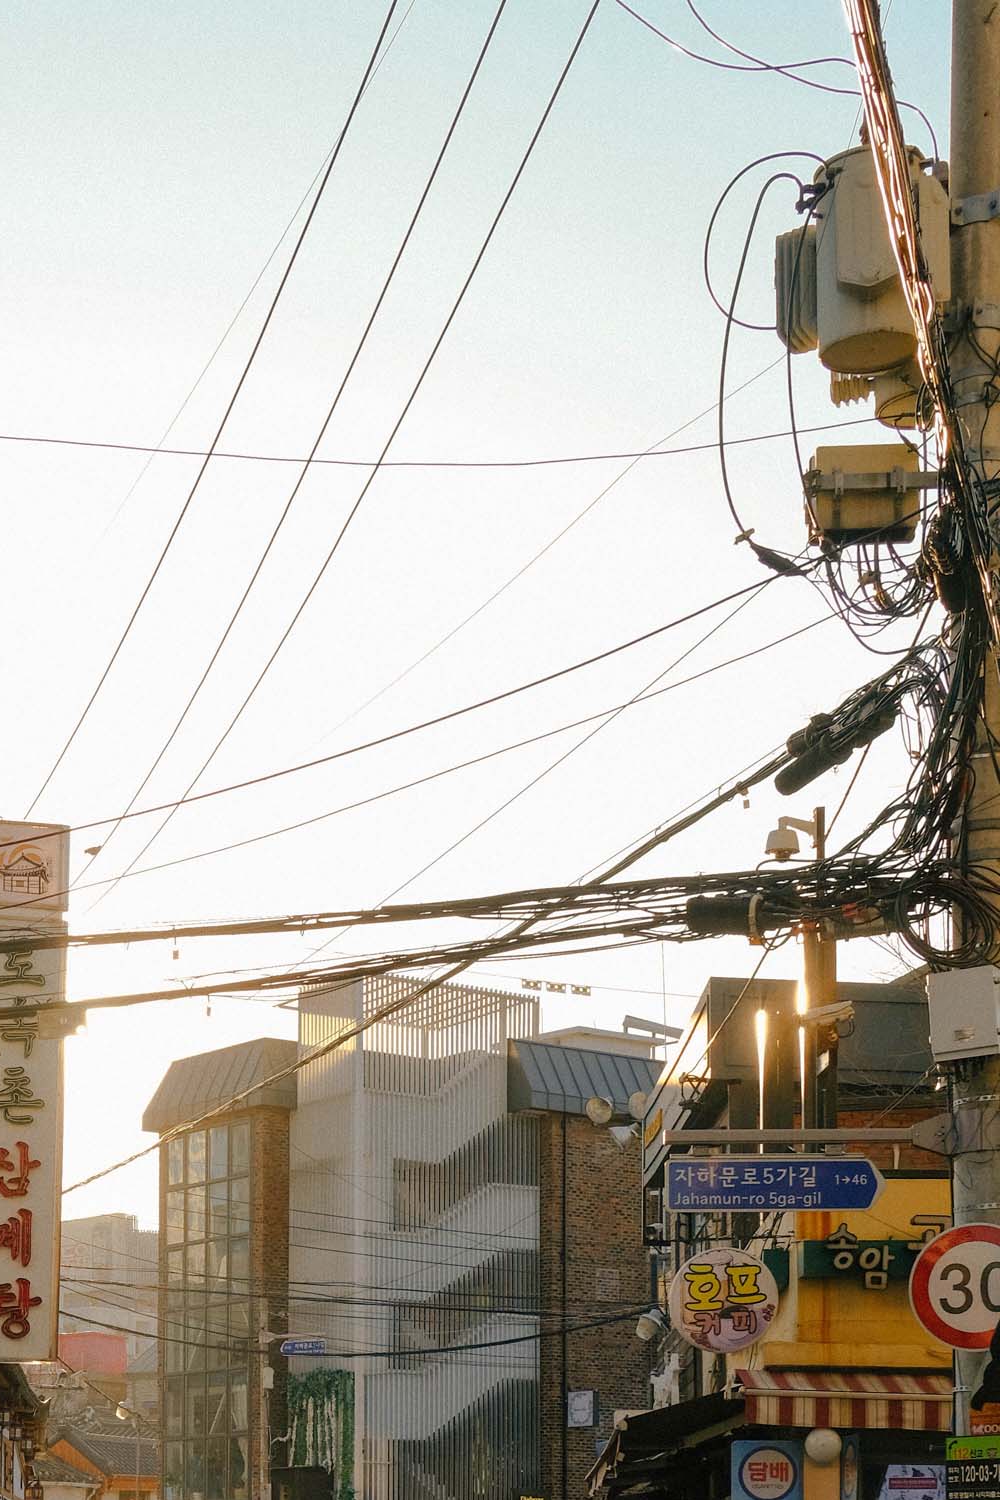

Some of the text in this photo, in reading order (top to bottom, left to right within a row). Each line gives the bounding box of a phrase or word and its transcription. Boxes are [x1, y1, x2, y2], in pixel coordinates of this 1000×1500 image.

[674, 1166, 817, 1188] 자하문로5가길
[674, 1192, 822, 1207] Jahamun-ro 5ga-gil
[684, 1264, 767, 1311] 호프
[690, 1310, 757, 1336] 커피
[748, 1462, 789, 1482] 담배
